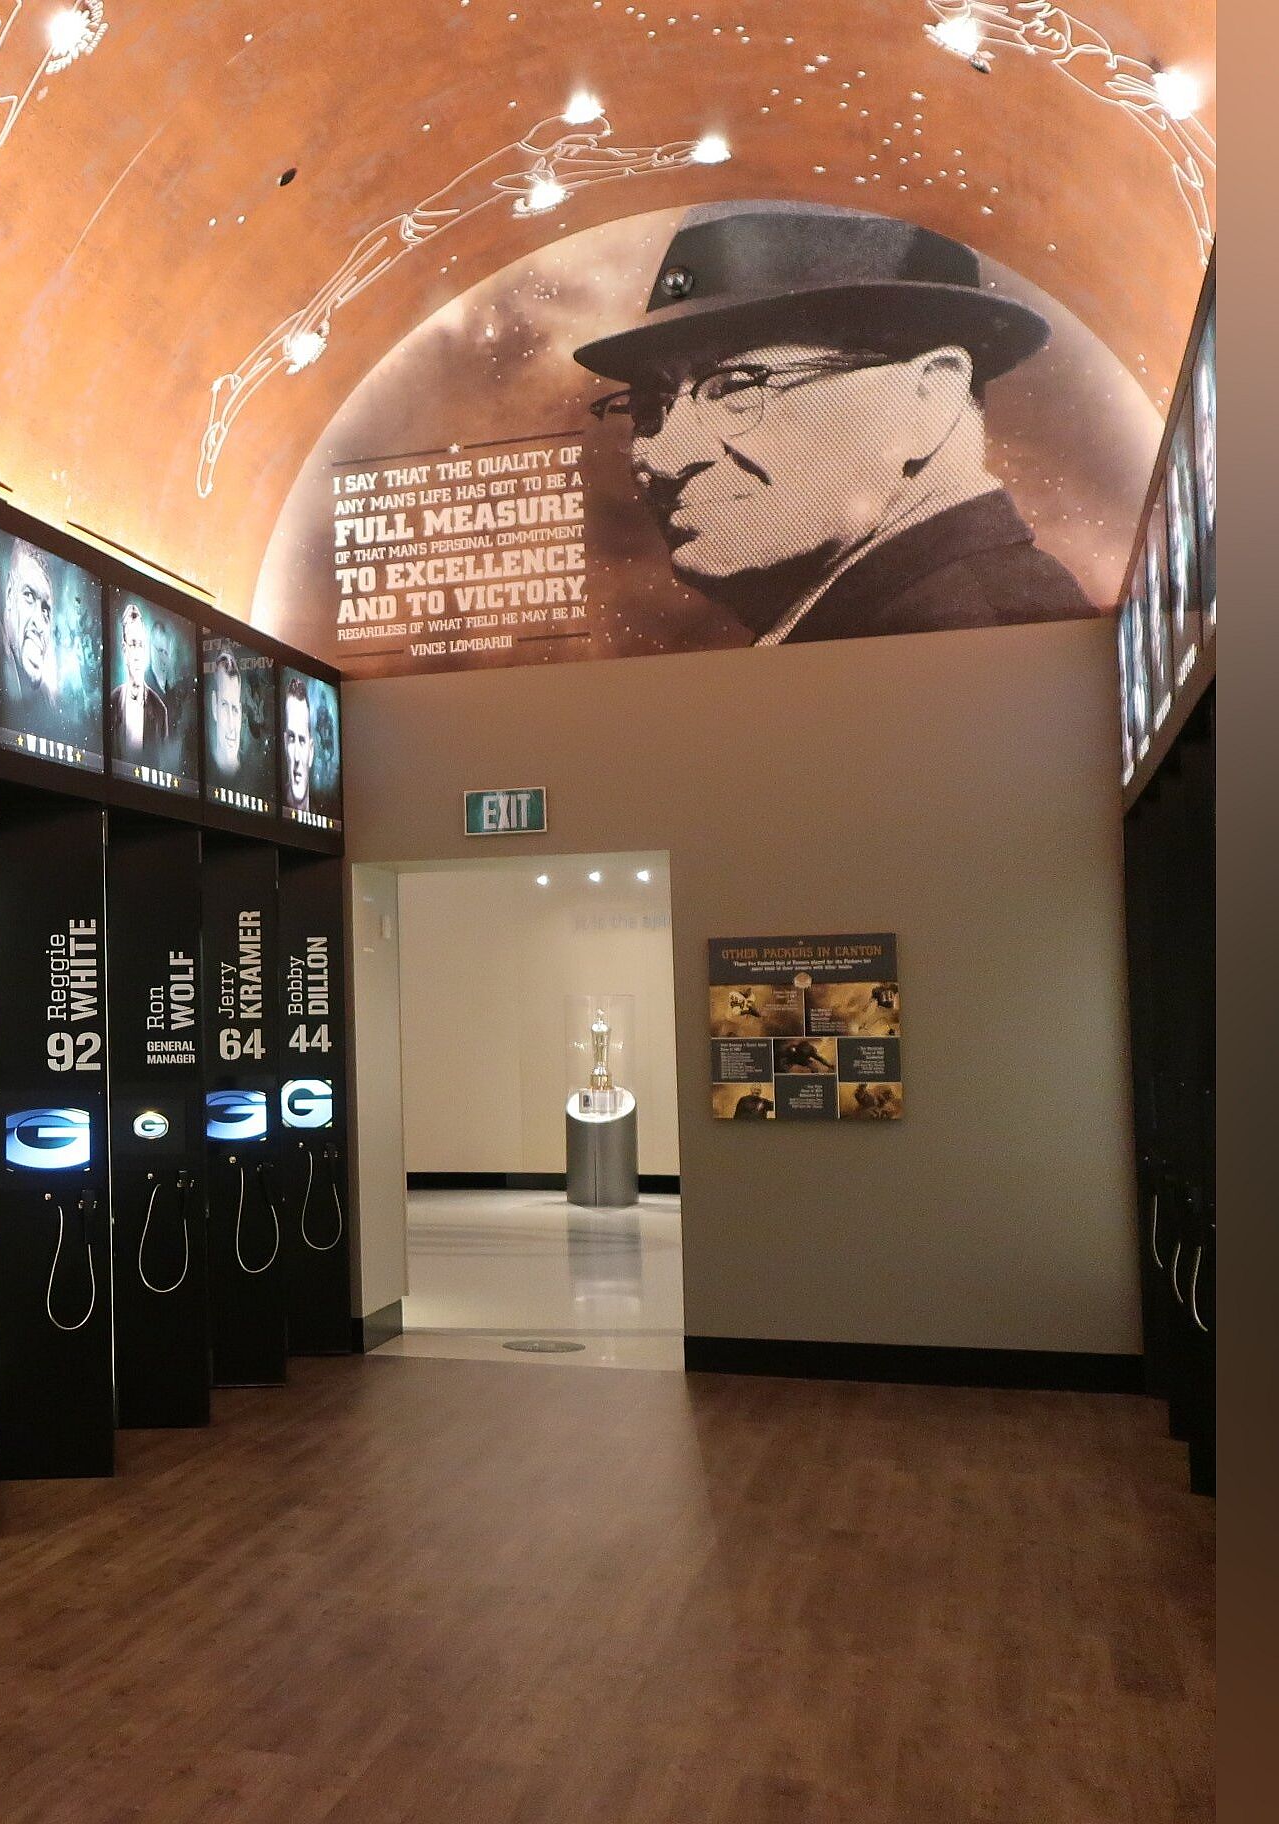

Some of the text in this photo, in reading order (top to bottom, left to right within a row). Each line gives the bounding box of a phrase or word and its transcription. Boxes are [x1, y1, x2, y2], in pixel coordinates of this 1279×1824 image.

[333, 445, 583, 495] I SAY THAT THE QUALITY OF
[334, 498, 366, 516] ANY
[420, 487, 452, 505] LIFE
[456, 482, 486, 500] HAS
[490, 479, 518, 496] GOT
[522, 476, 542, 492] TO
[547, 473, 566, 489] BE
[571, 471, 583, 487] A
[334, 491, 585, 547] FULL MEASURE
[335, 550, 350, 564] OF
[354, 547, 386, 562] THAT
[431, 534, 493, 554] PERSONAL
[497, 525, 585, 546] COMMITMENT
[335, 543, 586, 594] TO EXCELLENCE
[336, 575, 588, 624] AND TO VICTORY,
[337, 622, 407, 641] REGARDLESS
[410, 622, 424, 634] OF
[428, 617, 462, 633] WHAT
[466, 614, 498, 629] FIELD
[502, 612, 518, 625] HE
[521, 609, 547, 623] MAY
[552, 607, 568, 620] BE
[410, 635, 513, 657] VINCE LOMBARDI
[26, 734, 73, 762] WHITE
[221, 787, 264, 813] KRAMER
[482, 793, 531, 830] EXIT
[70, 920, 97, 1021] WHITE
[239, 911, 262, 1018] KRAMER
[723, 945, 882, 959] OTHER PACKERS IN CANTON
[46, 932, 70, 1021] Reggie
[170, 952, 194, 1030] WOLF
[219, 961, 237, 1019] Jerry
[287, 955, 306, 1017] Bobby
[308, 937, 328, 1014] DILLON
[147, 986, 164, 1030] Ron
[47, 1032, 101, 1071] 92
[147, 1041, 195, 1051] GENERAL
[147, 1054, 195, 1064] MANAGER
[220, 1029, 265, 1060] 64
[289, 1024, 331, 1052] 44
